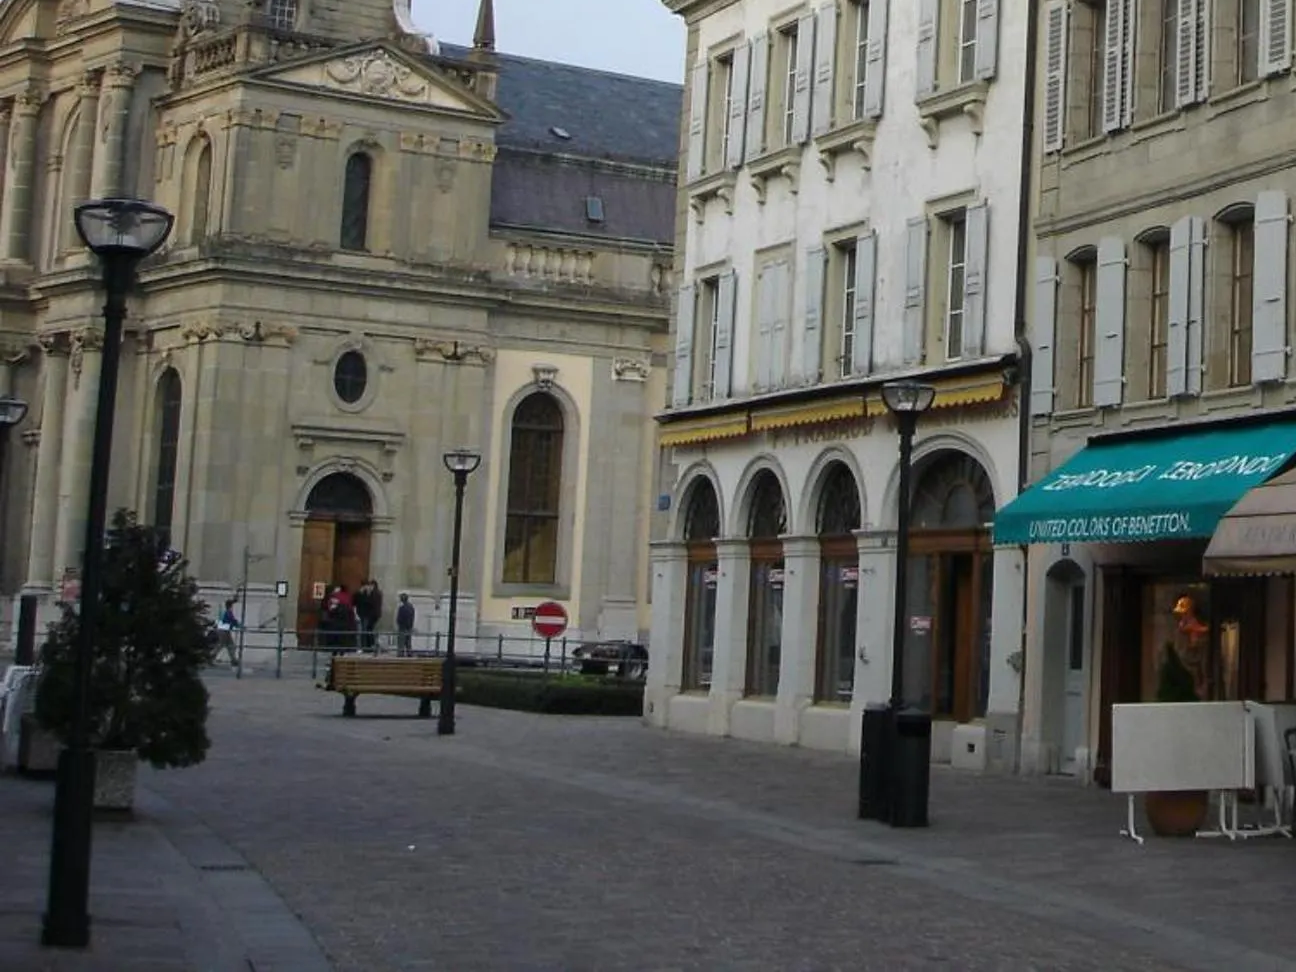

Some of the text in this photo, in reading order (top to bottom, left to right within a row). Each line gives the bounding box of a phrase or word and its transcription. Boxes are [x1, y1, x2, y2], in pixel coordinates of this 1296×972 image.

[1029, 518, 1066, 537] UNITED
[1067, 516, 1110, 536] COLORS
[1111, 515, 1128, 535] OF
